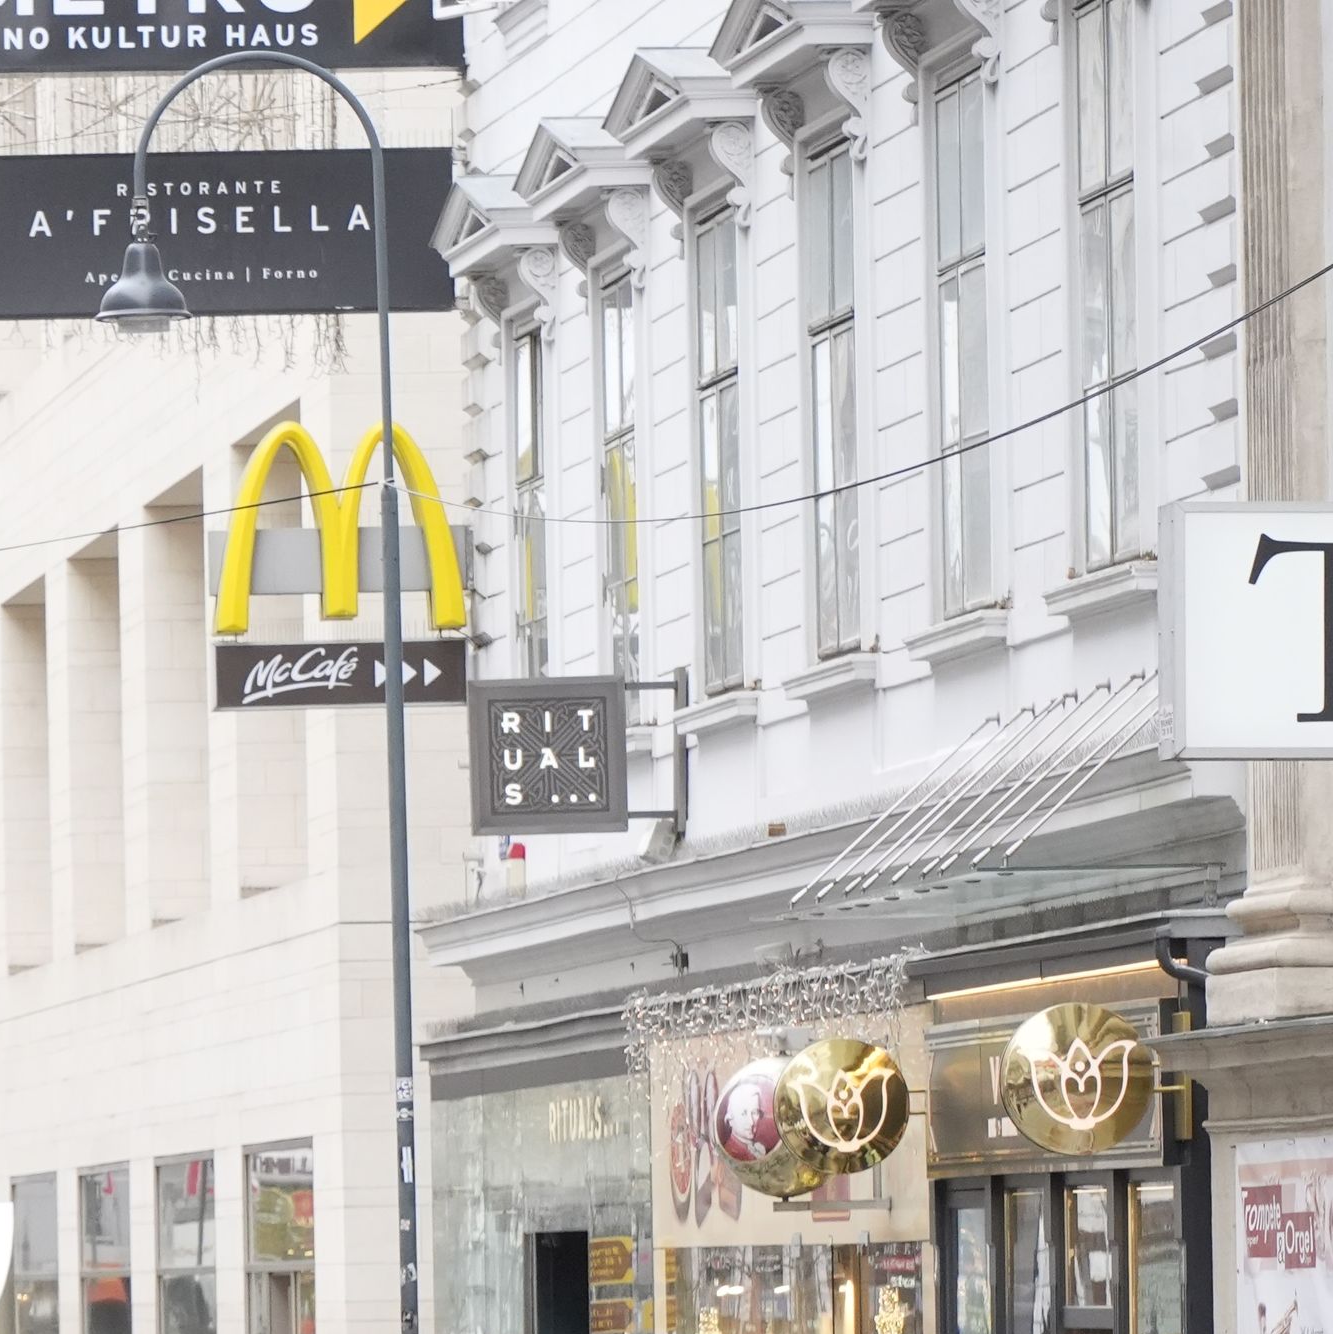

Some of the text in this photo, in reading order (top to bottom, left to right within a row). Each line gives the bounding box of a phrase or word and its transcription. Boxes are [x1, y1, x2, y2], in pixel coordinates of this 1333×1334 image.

[67, 24, 207, 50] KULTUR
[225, 23, 319, 48] HAUS
[117, 180, 283, 197] RSTORANTE
[168, 268, 235, 281] Cucina
[262, 265, 320, 279] Forno
[242, 646, 359, 704] McCafé
[1285, 1216, 1314, 1264] Orgel
